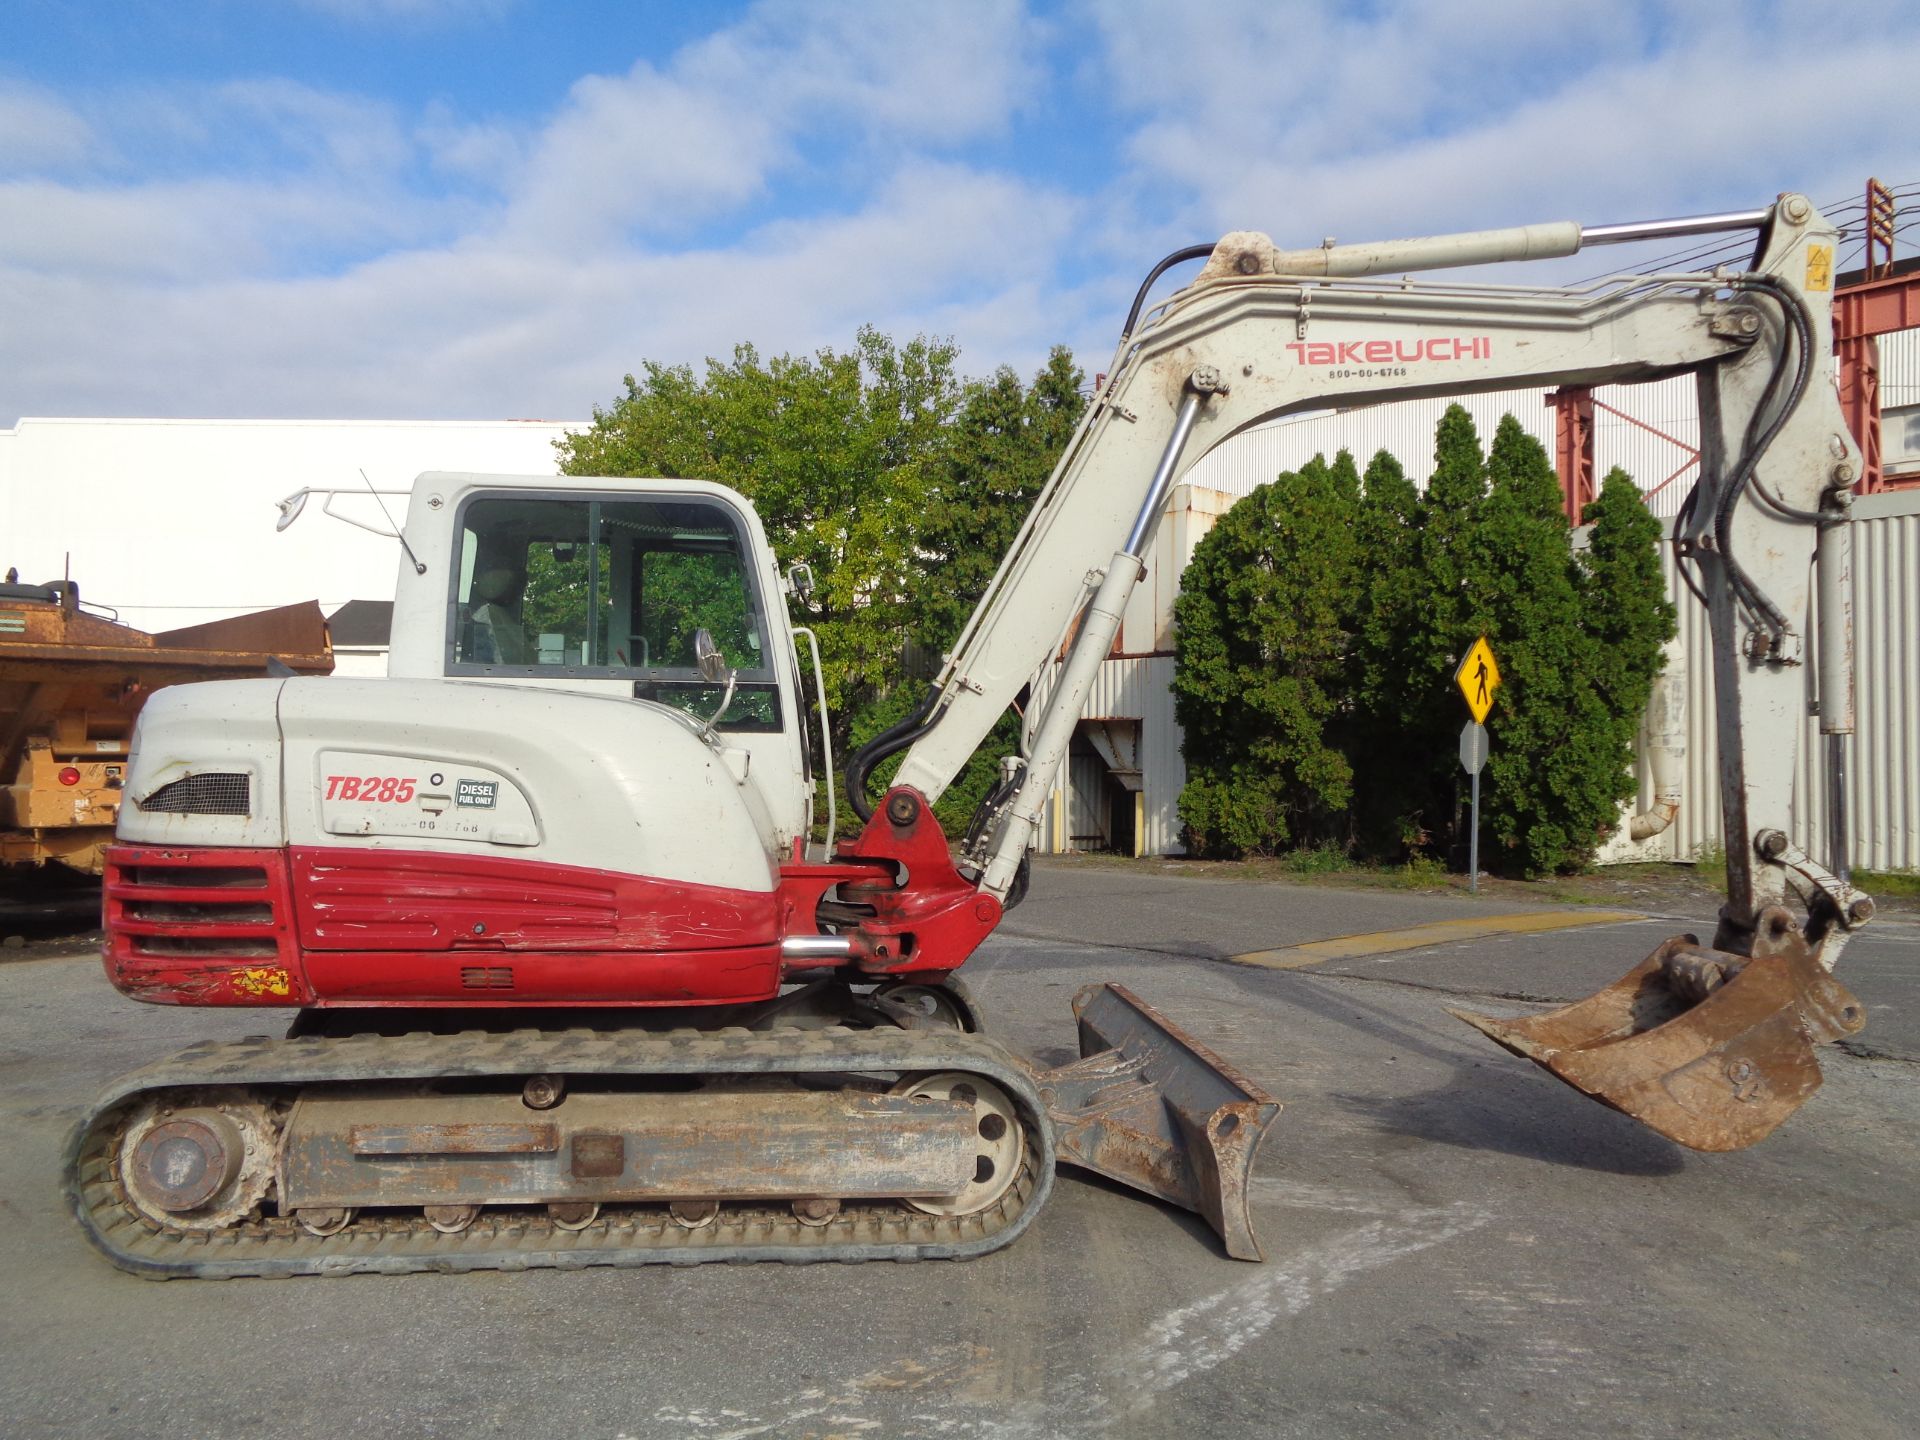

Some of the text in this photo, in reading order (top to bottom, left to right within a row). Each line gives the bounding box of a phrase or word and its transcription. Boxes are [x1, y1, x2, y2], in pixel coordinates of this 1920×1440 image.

[326, 776, 417, 803] TB285
[460, 784, 494, 797] DIESEL
[458, 795, 492, 805] FUEL ONLY
